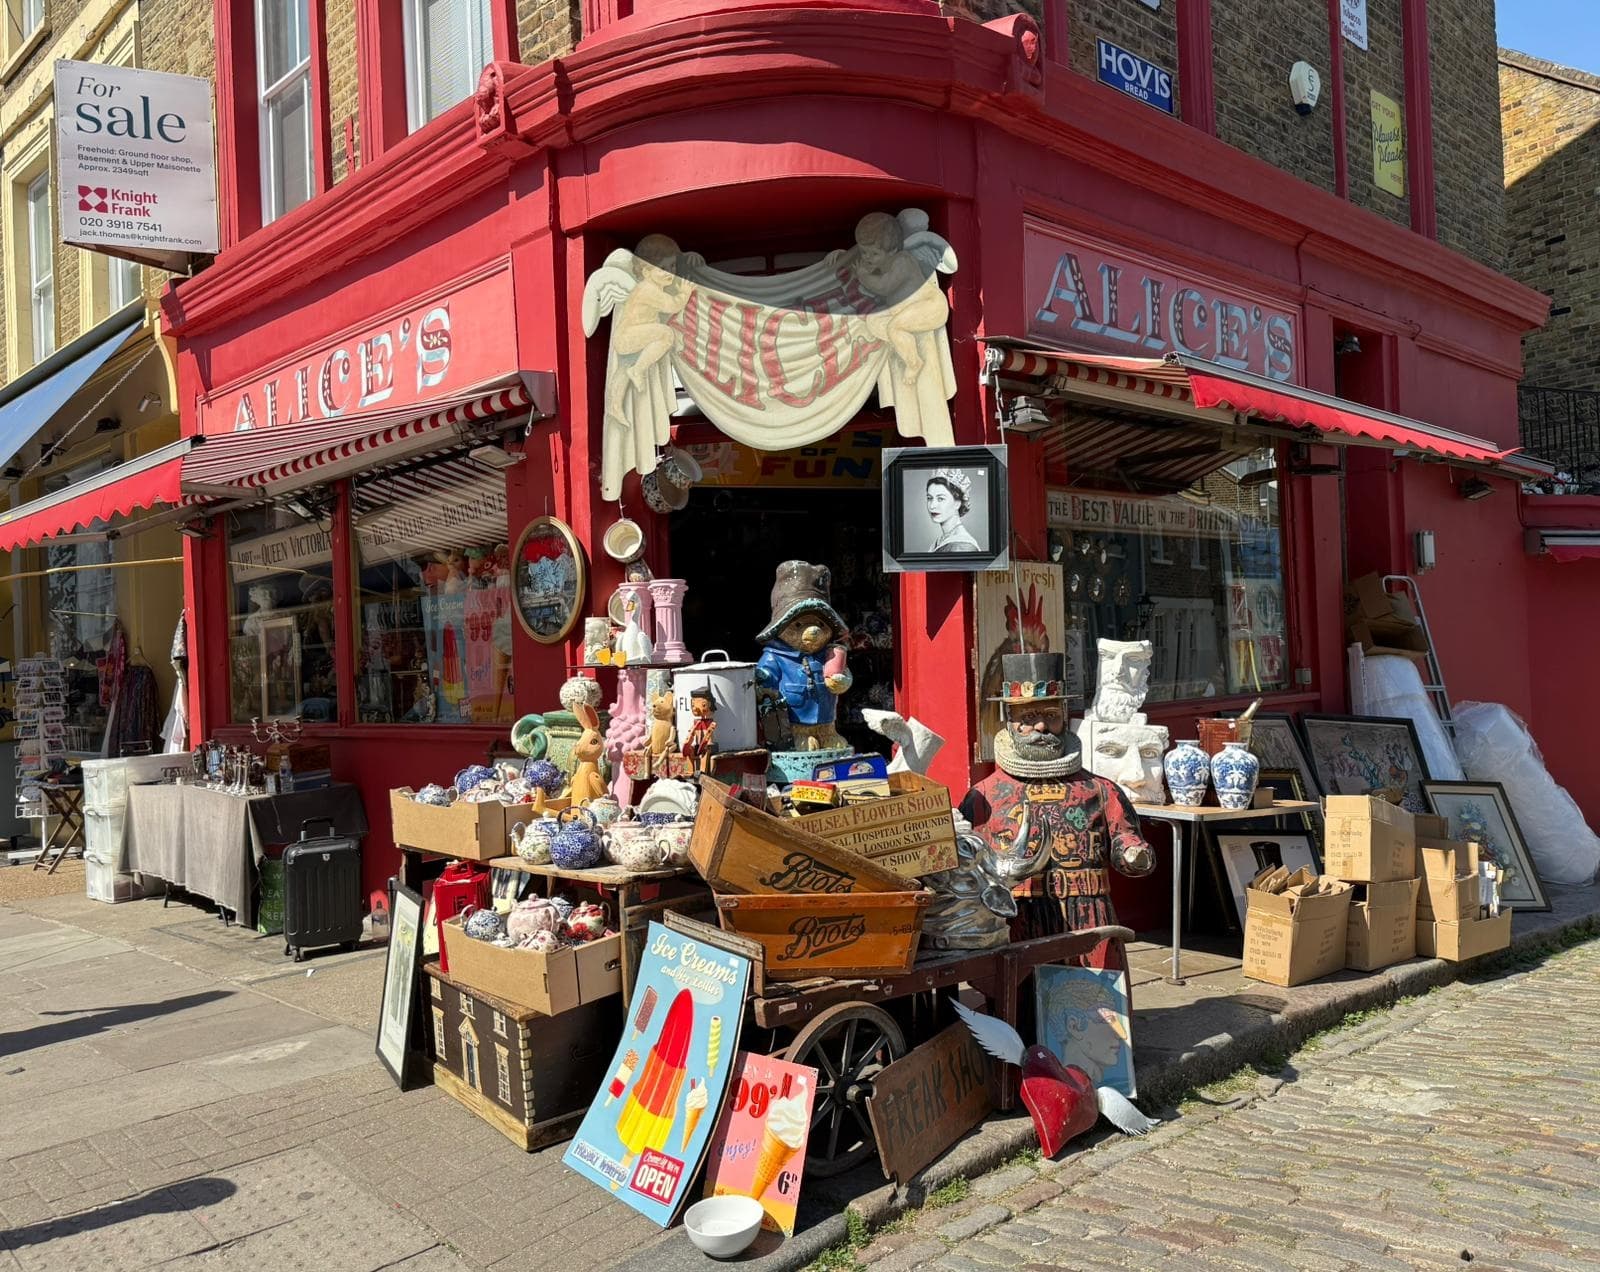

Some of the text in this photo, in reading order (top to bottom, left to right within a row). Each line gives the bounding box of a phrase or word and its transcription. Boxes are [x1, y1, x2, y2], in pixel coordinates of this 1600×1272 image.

[1100, 42, 1171, 98] HOVIS
[76, 76, 121, 98] For
[1124, 82, 1149, 100] BREAD
[76, 95, 187, 143] sale
[77, 144, 193, 165] Freehold: Ground floor shop,
[77, 153, 120, 165] Basement
[130, 160, 155, 171] Upper
[156, 162, 202, 173] Maisonette
[78, 162, 150, 177] Approx. 2349sqft
[111, 188, 158, 206] Knight
[111, 203, 152, 217] Frank
[80, 216, 162, 232] 020 3918 7541
[80, 228, 202, 245] jack.thomas@knightfrank.com
[1035, 250, 1295, 383] ALICE'S
[234, 299, 453, 432] ALICE'S
[800, 448, 838, 456] OF
[760, 456, 873, 479] FUN
[482, 492, 506, 515] ISLE
[1049, 501, 1068, 517] THE
[1071, 496, 1108, 522] BEST
[1112, 499, 1154, 527] VALUE
[1158, 510, 1166, 524] IN
[1170, 511, 1186, 525] THE
[1188, 506, 1233, 532] BRITISH
[261, 540, 288, 566] QUEEN
[290, 532, 333, 558] VICTORIA
[1022, 566, 1056, 590] Fresh
[852, 801, 906, 825] FLOWER
[907, 793, 945, 813] SHOW
[852, 826, 902, 844] HOSPITAL
[904, 815, 950, 833] GROUNDS
[863, 830, 932, 855] LONDON S.W.3
[890, 850, 922, 867] SHOW
[760, 851, 857, 893] Boots
[776, 912, 867, 962] Boots
[650, 932, 738, 986] Ice Creams
[660, 964, 679, 978] and
[880, 1038, 988, 1146] FREAK SHO
[718, 1139, 758, 1165] Enjoy!
[634, 1164, 677, 1200] OPEN
